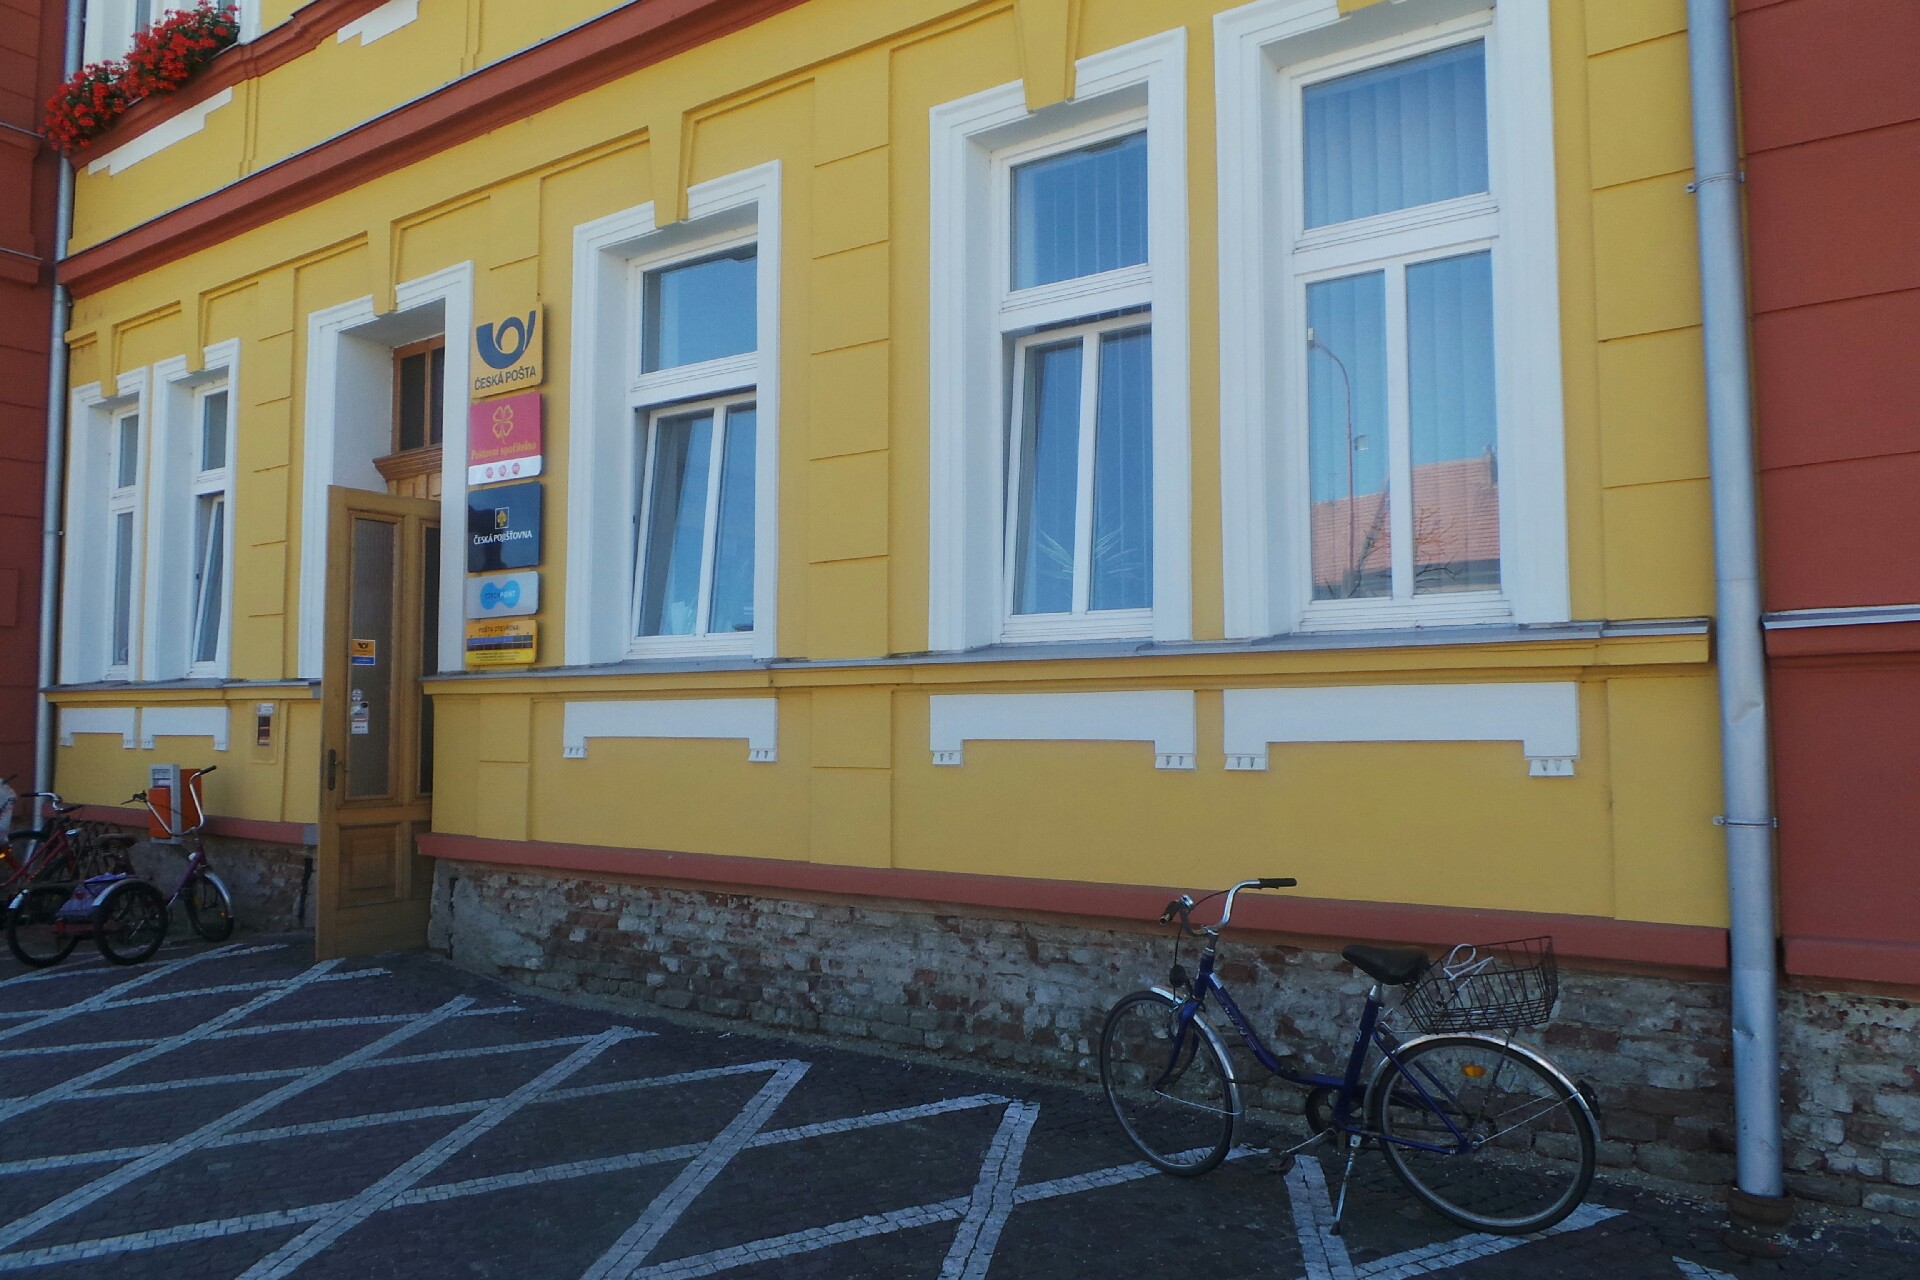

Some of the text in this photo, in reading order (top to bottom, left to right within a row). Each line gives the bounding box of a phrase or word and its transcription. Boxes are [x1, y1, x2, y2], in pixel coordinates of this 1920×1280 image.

[474, 366, 536, 390] ČESKÁ POŠTA
[473, 530, 533, 545] ČESKÁ POJIŠŤOVNA
